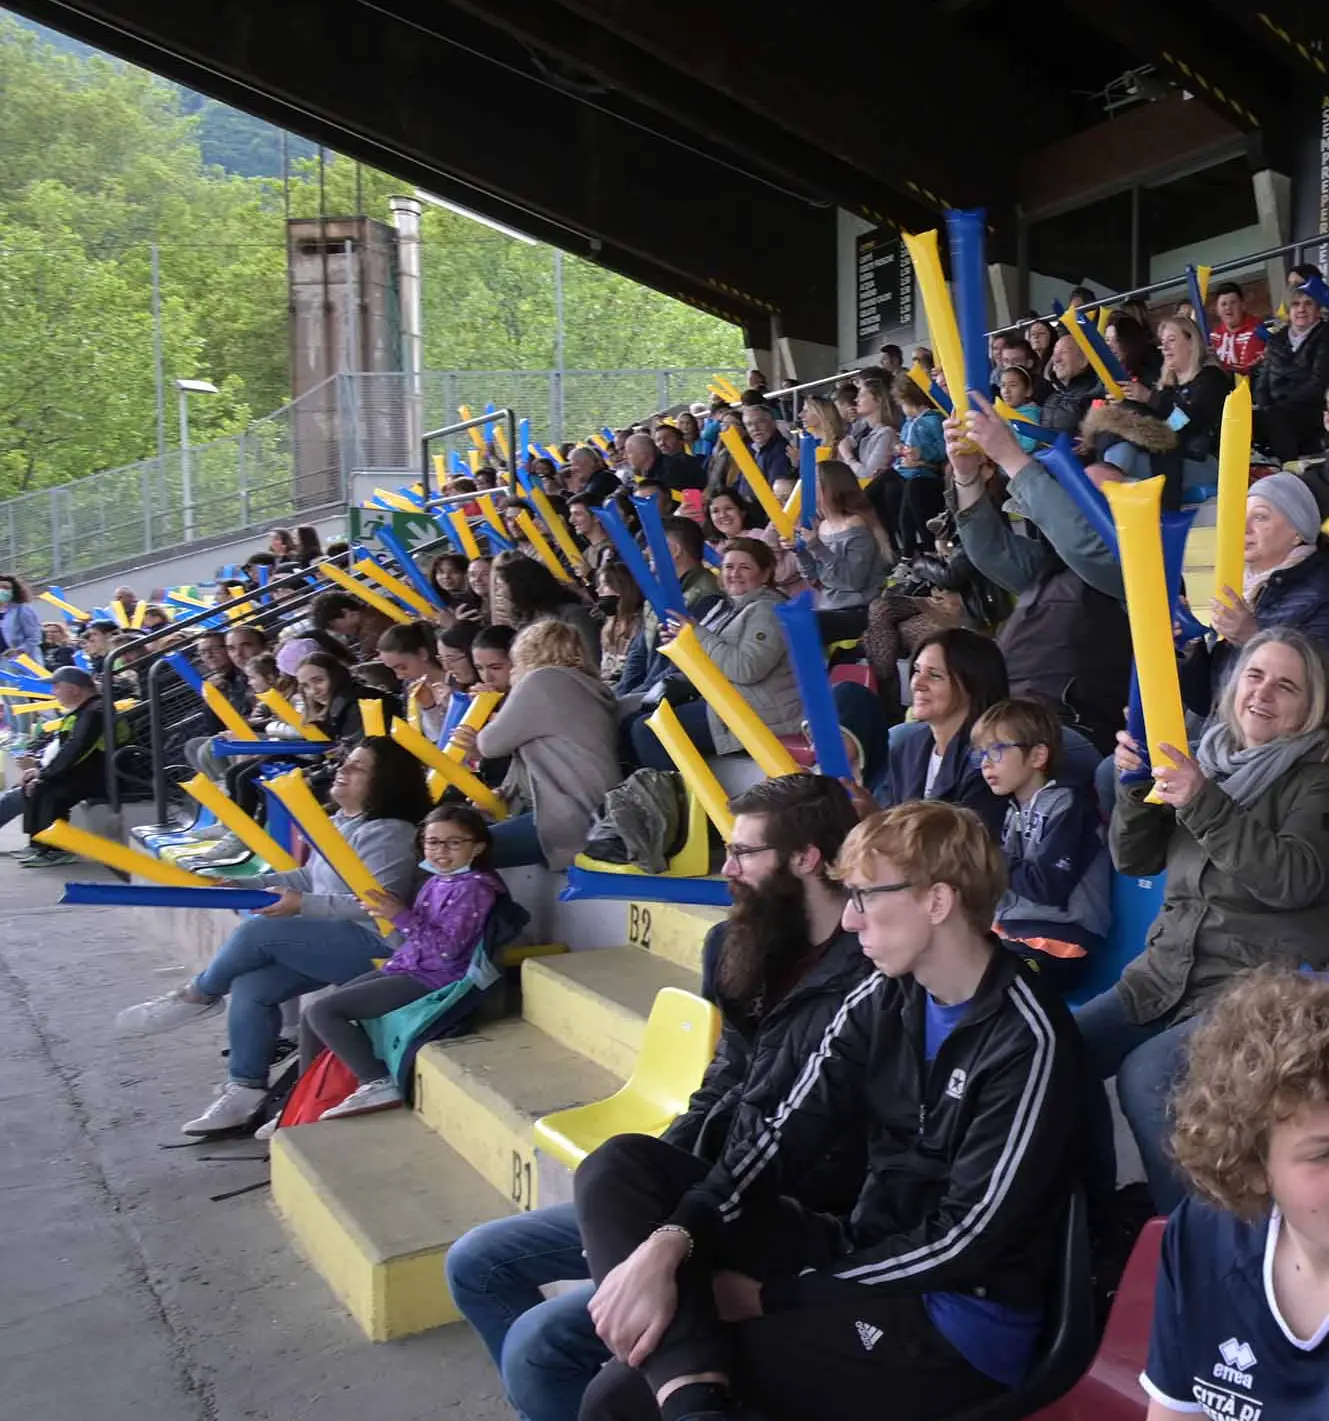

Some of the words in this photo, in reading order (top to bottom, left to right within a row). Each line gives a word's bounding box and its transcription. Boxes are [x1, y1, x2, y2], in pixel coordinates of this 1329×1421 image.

[629, 904, 651, 948] B2
[416, 1073, 424, 1114] 1
[512, 1150, 532, 1212] B1
[1192, 1385, 1236, 1416] CITTÀ
